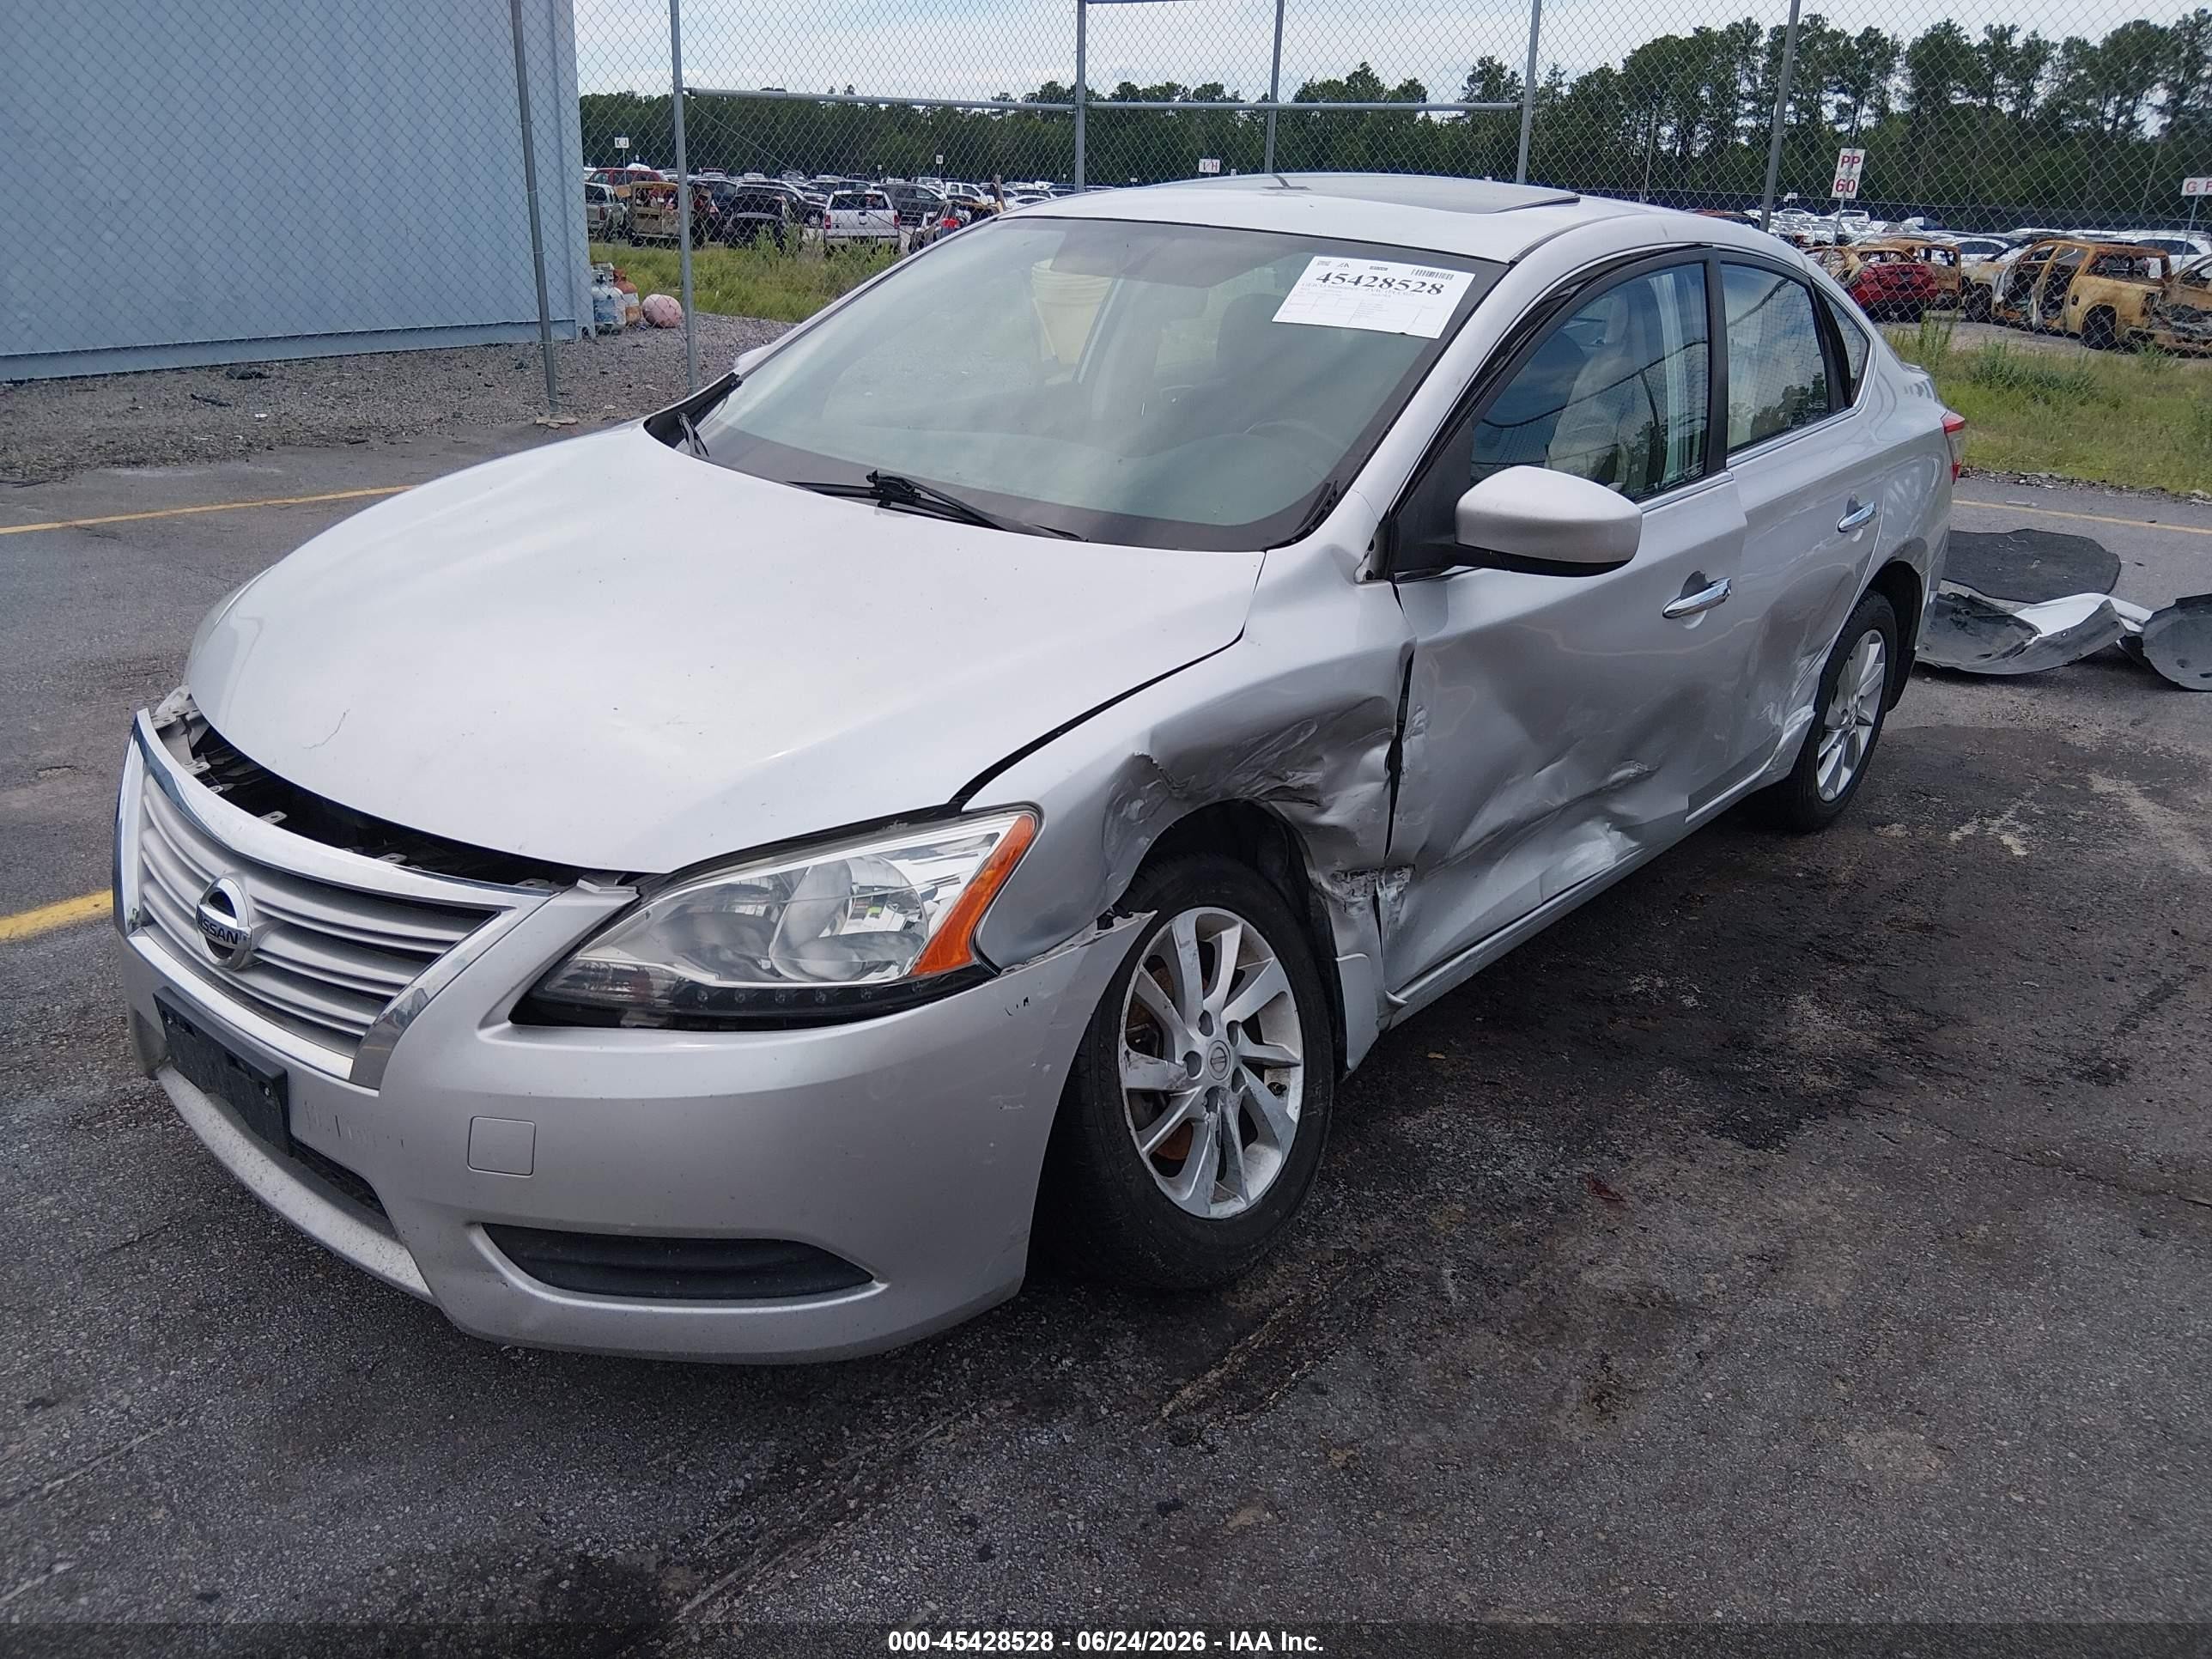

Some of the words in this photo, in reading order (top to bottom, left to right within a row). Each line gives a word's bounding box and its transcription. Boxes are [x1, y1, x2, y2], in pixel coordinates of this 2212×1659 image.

[1840, 155, 1861, 169] PP
[1835, 179, 1856, 193] 60
[2186, 181, 2198, 193] G
[1316, 271, 1445, 295] 45428528
